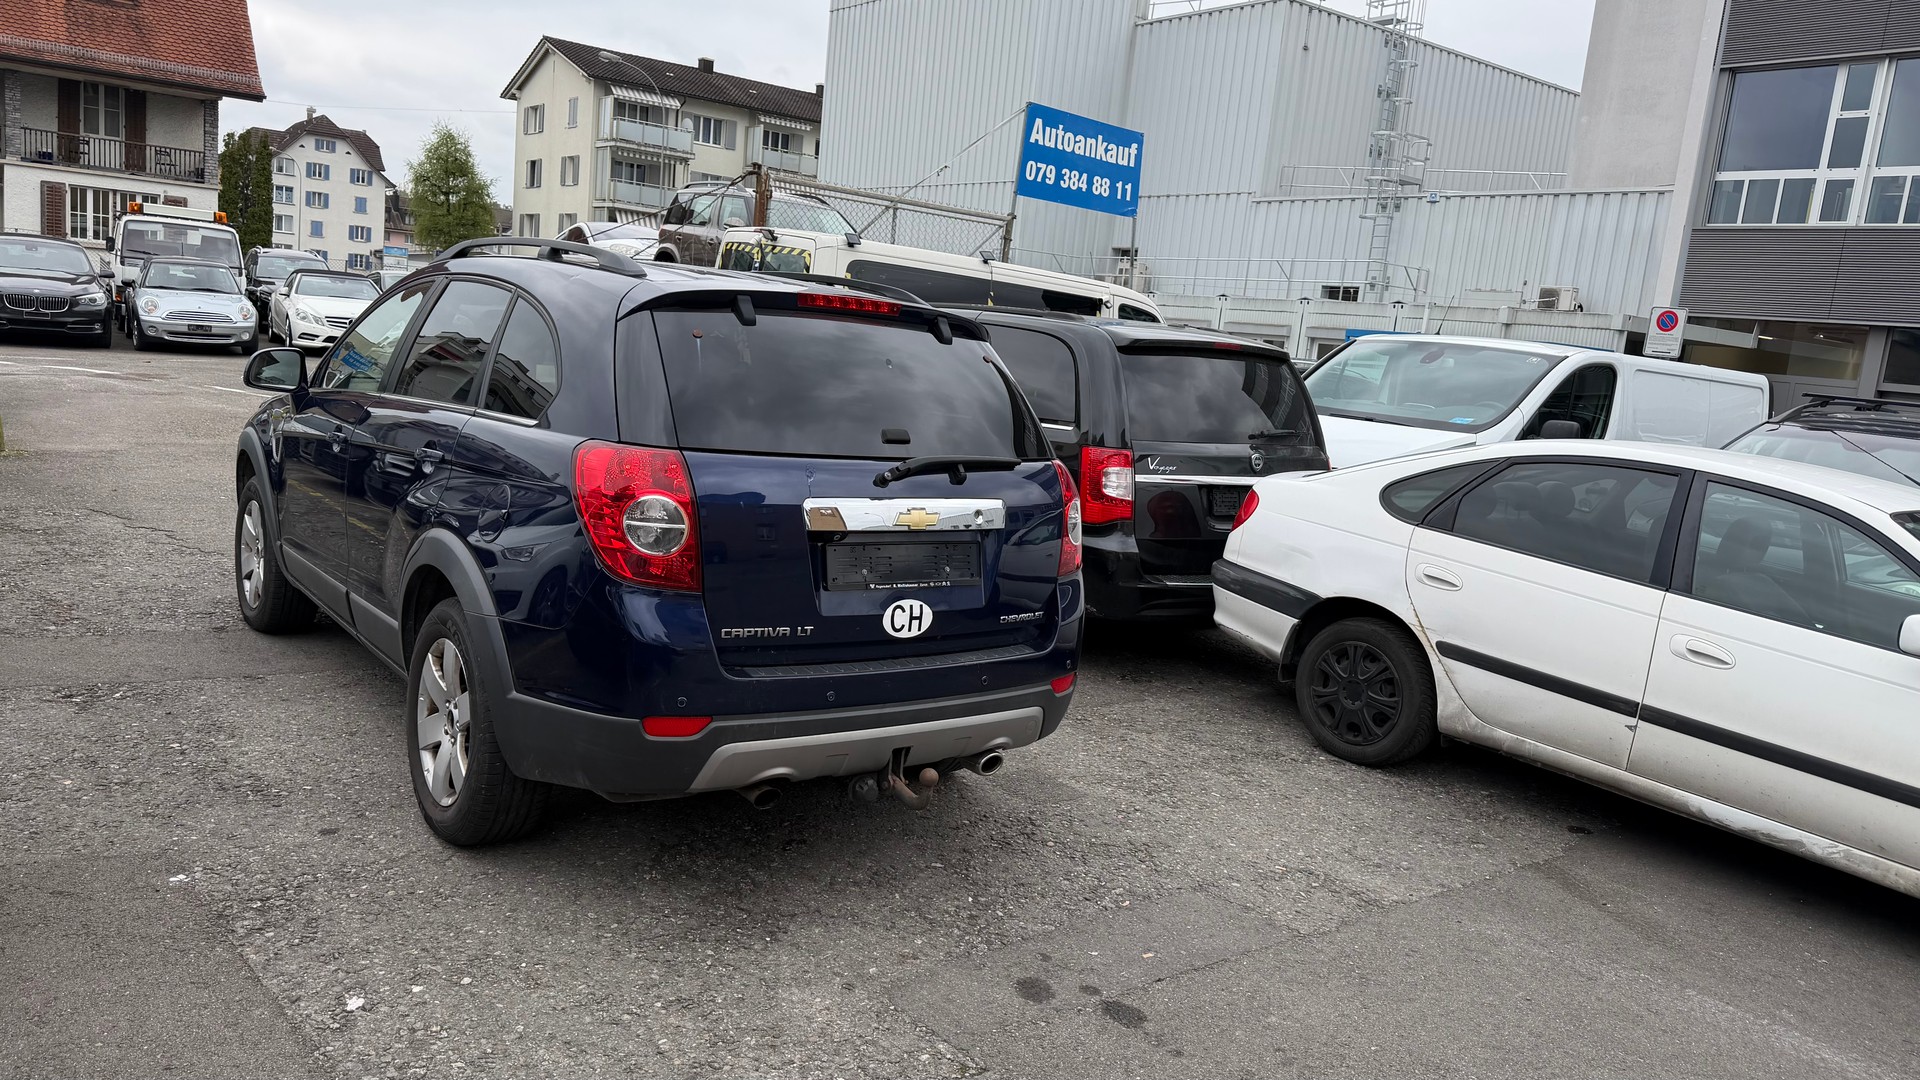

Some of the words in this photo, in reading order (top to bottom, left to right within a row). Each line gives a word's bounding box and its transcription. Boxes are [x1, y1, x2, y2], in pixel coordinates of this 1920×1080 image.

[1029, 117, 1138, 167] Autoankauf
[1025, 160, 1056, 185] 079
[1060, 168, 1088, 192] 384
[1092, 175, 1111, 197] 88
[1116, 181, 1132, 201] 11
[1147, 456, 1177, 473] Voyager
[890, 604, 924, 633] CH
[1000, 611, 1045, 624] CHEVROLET
[721, 627, 791, 639] CAPTIVA
[797, 626, 815, 637] LT
